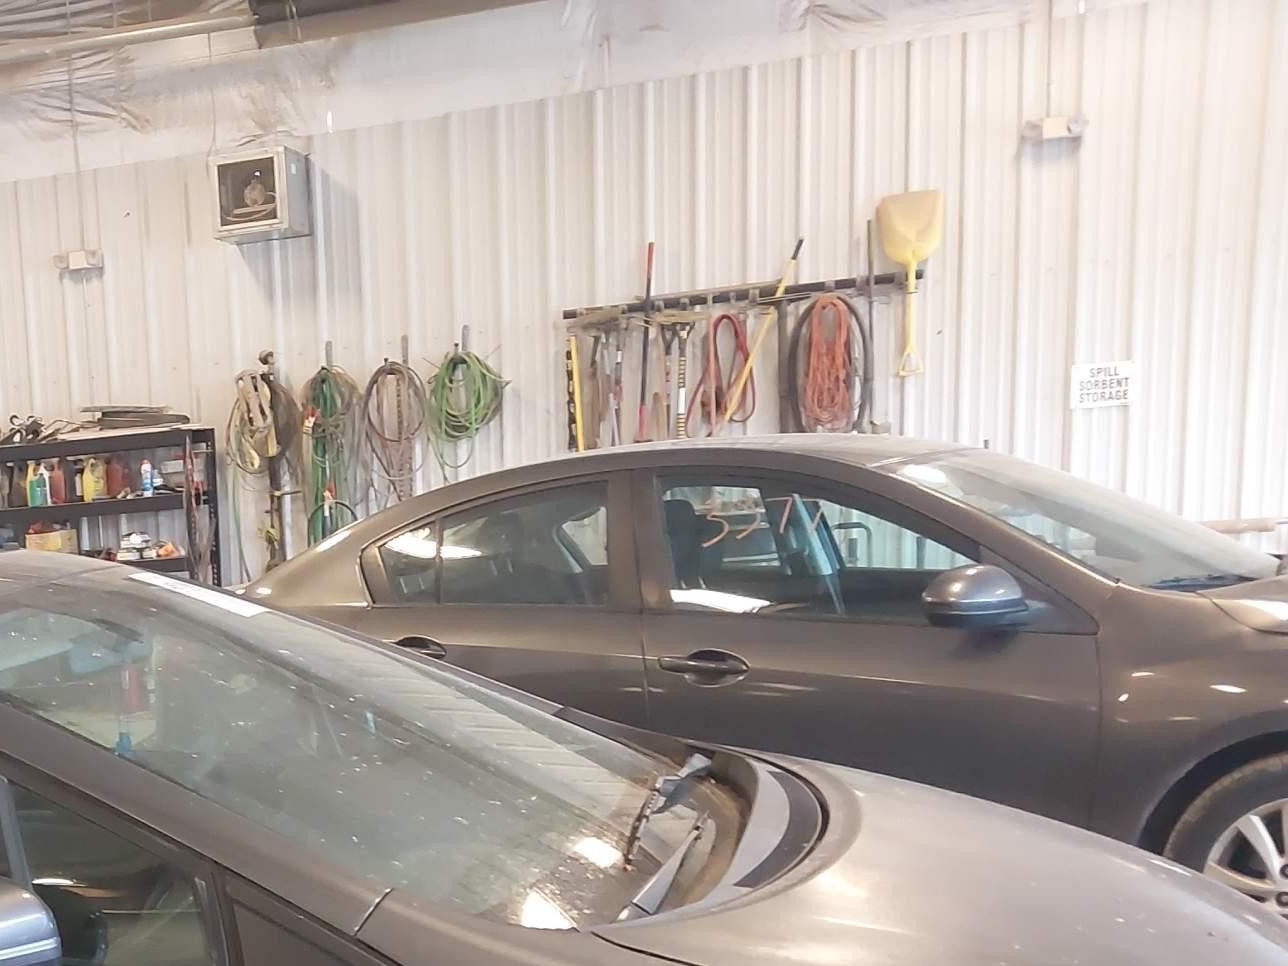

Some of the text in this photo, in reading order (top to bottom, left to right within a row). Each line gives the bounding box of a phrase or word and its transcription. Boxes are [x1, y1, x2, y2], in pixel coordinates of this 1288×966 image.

[1089, 366, 1120, 378] SPILL
[1079, 377, 1129, 392] SORBENT
[1079, 389, 1128, 403] STORAGE
